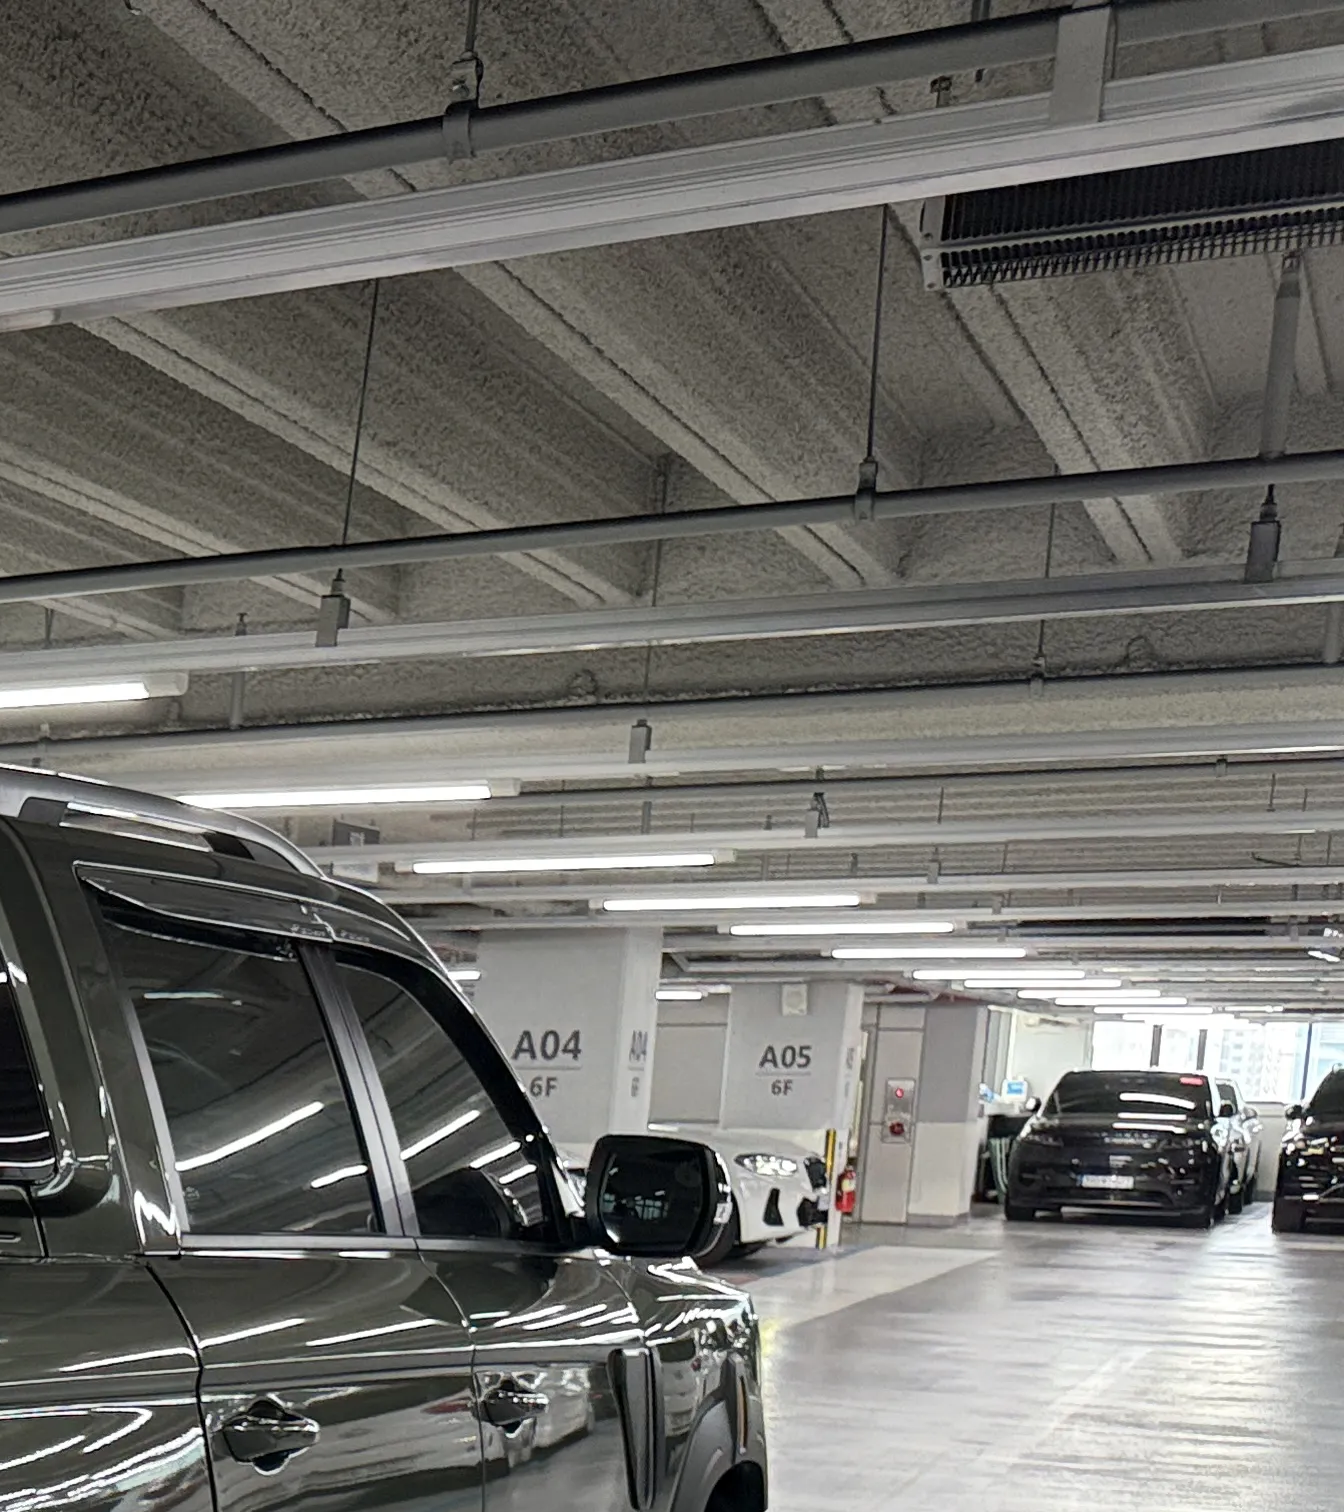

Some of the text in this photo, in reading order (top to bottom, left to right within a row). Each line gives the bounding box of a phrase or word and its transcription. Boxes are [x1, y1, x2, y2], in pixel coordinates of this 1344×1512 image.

[513, 1029, 582, 1061] A04
[759, 1045, 812, 1069] A05
[529, 1076, 558, 1098] 6F
[770, 1079, 794, 1096] 6F
